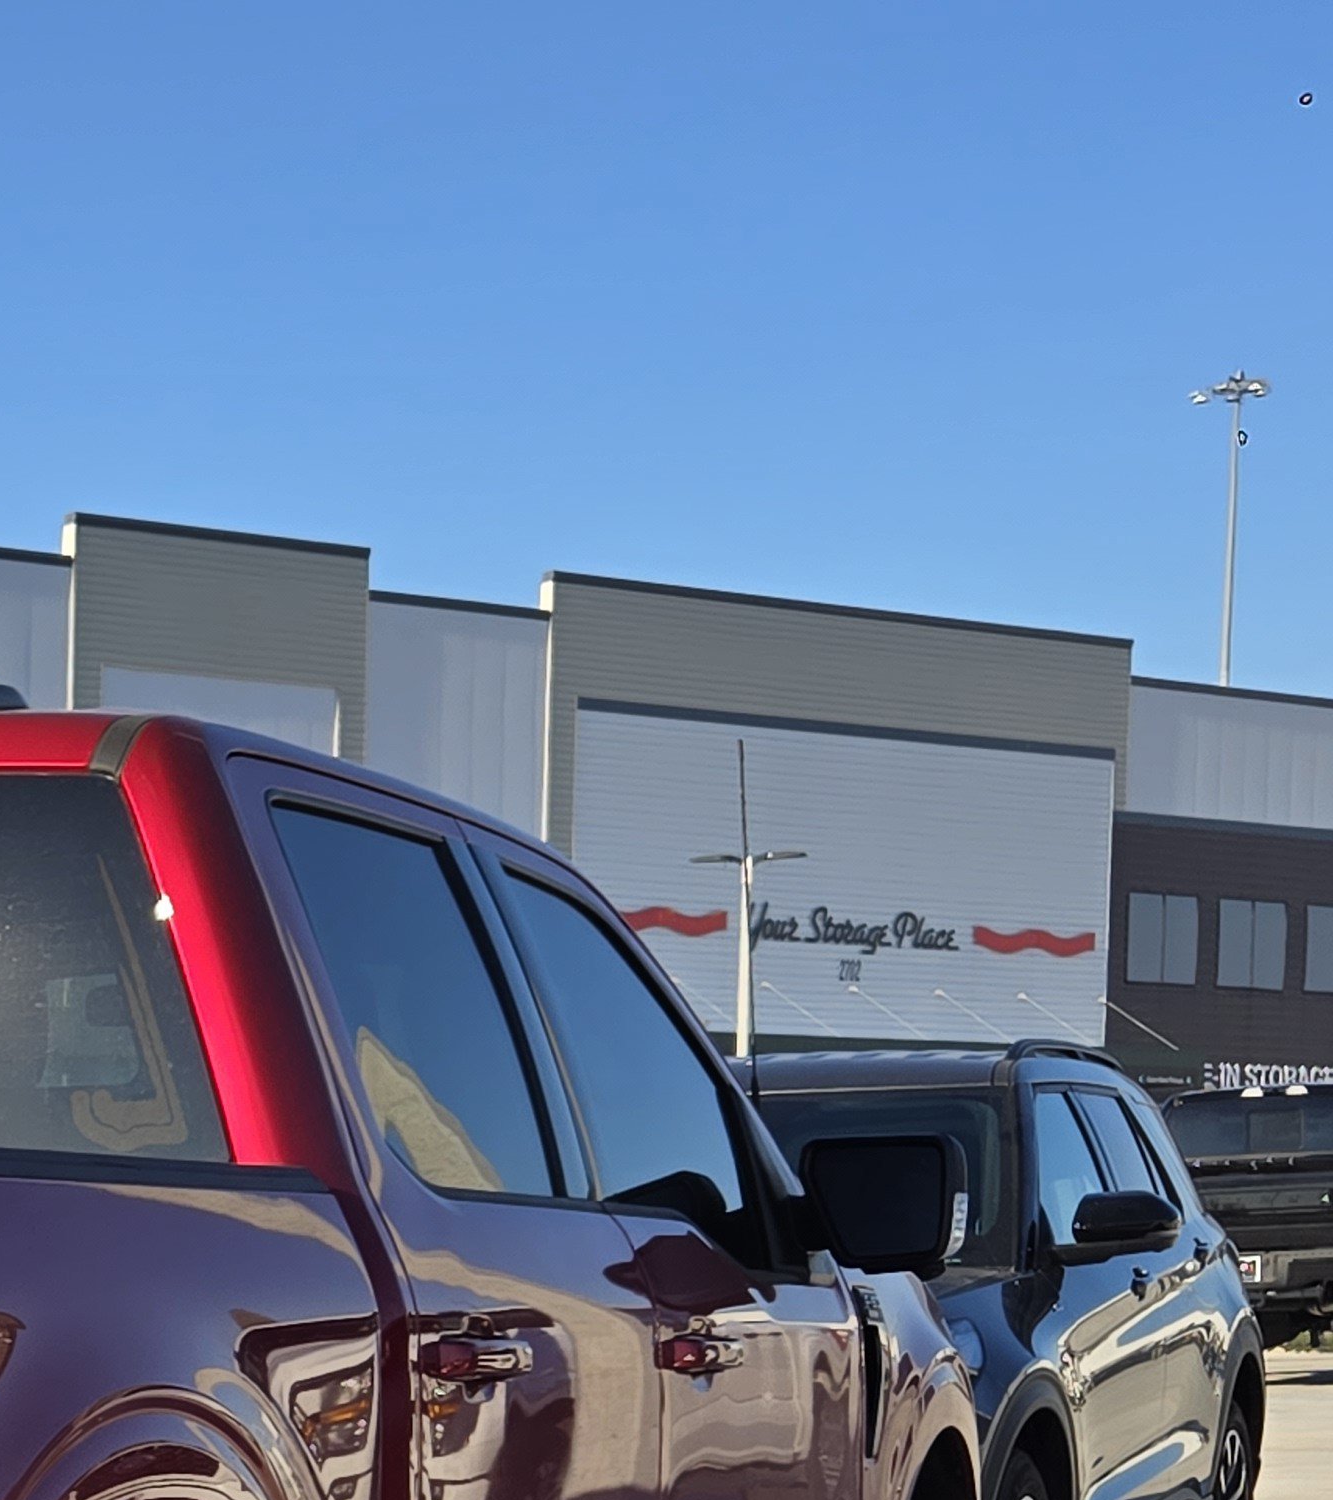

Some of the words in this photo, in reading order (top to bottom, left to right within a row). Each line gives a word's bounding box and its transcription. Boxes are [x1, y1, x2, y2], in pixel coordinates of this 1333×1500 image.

[749, 901, 801, 952] Your
[804, 906, 892, 955] Storage
[892, 911, 960, 951] Place
